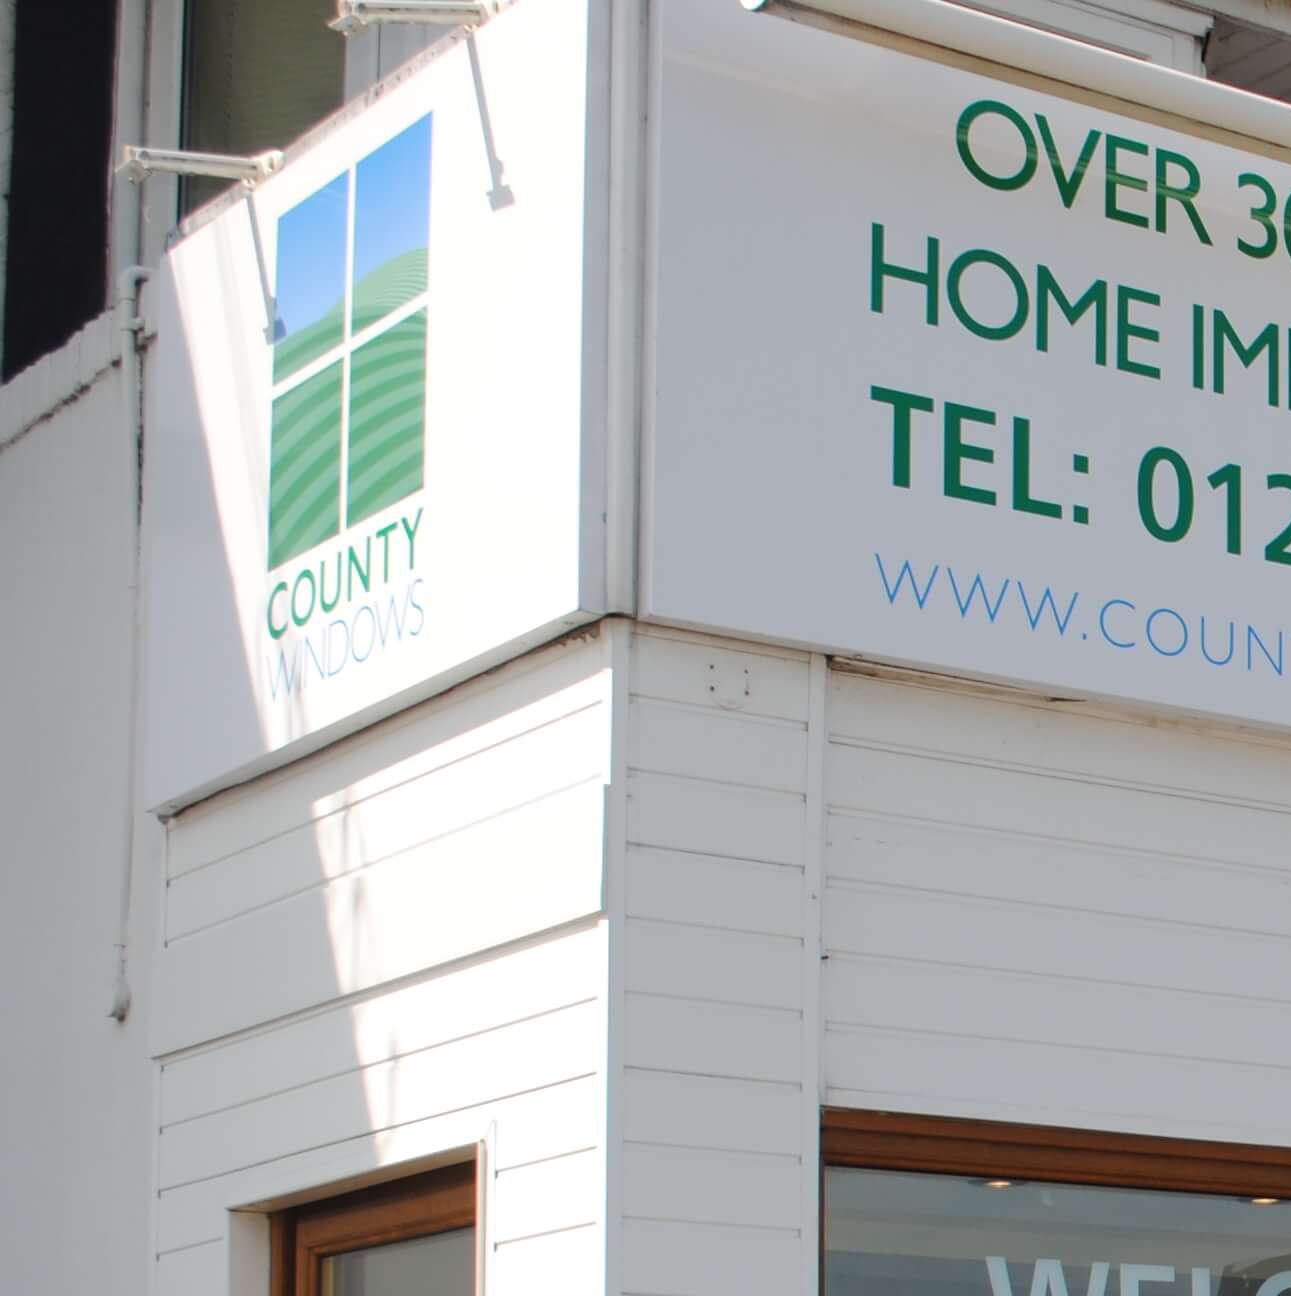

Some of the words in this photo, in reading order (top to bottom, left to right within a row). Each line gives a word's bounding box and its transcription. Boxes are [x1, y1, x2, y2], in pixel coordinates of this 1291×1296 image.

[956, 99, 1212, 245] OVER
[869, 222, 1160, 381] HOME
[869, 385, 1090, 524] TEL:
[266, 578, 425, 702] WINDOWS
[267, 507, 424, 640] COUNTY
